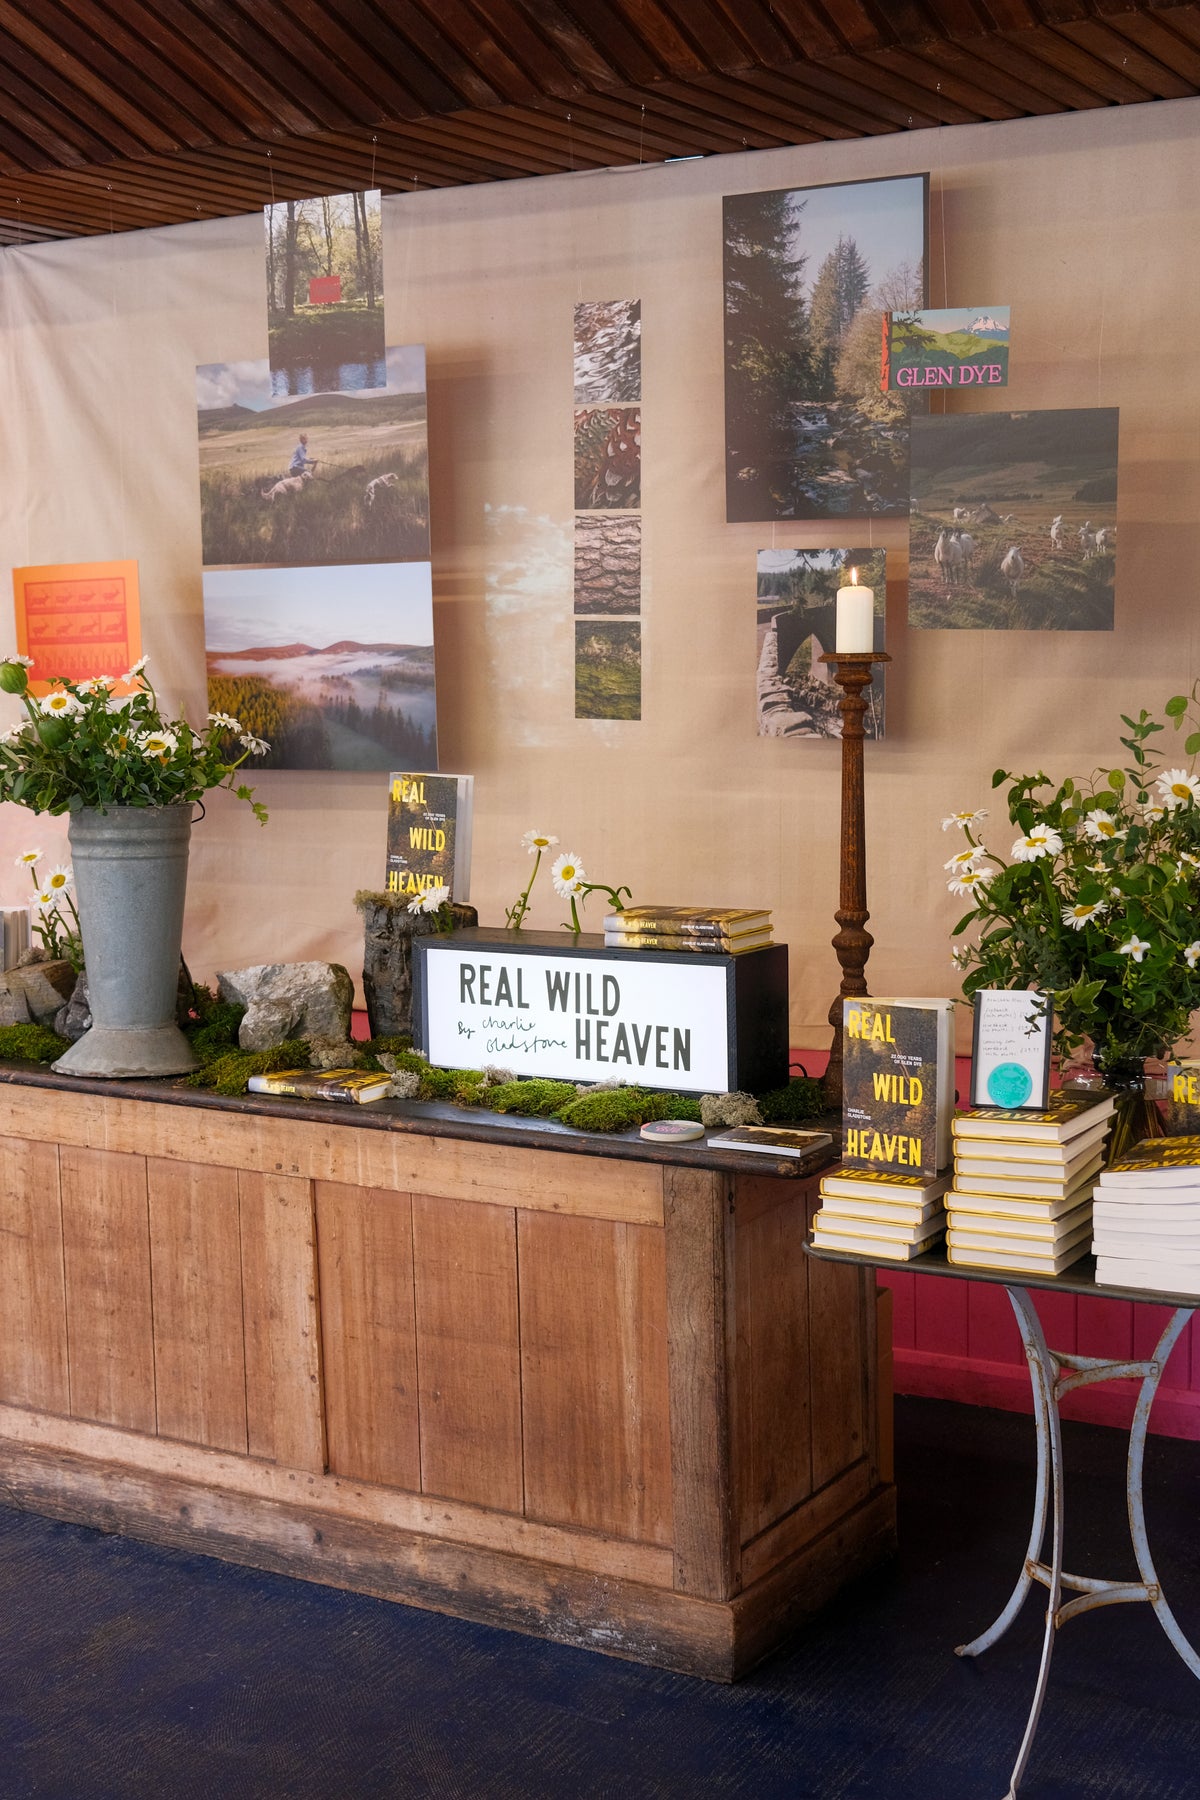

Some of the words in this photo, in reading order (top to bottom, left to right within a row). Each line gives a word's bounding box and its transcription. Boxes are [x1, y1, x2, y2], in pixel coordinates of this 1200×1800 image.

[897, 366, 954, 387] GLEN
[958, 364, 1002, 384] DYE
[392, 779, 427, 804] REAL
[409, 827, 446, 851] WILD
[459, 963, 530, 1009] REAL
[545, 970, 621, 1017] WILD
[458, 1021, 475, 1039] By
[847, 1010, 896, 1043] REAL
[575, 1018, 691, 1072] HEAVEN
[872, 1072, 923, 1106] WILD
[1173, 1074, 1200, 1105] RE
[967, 1110, 1059, 1122] HEAVEN
[847, 1128, 922, 1167] HEAVEN
[1162, 1147, 1200, 1157] WIL
[835, 1169, 923, 1184] HEAVEN
